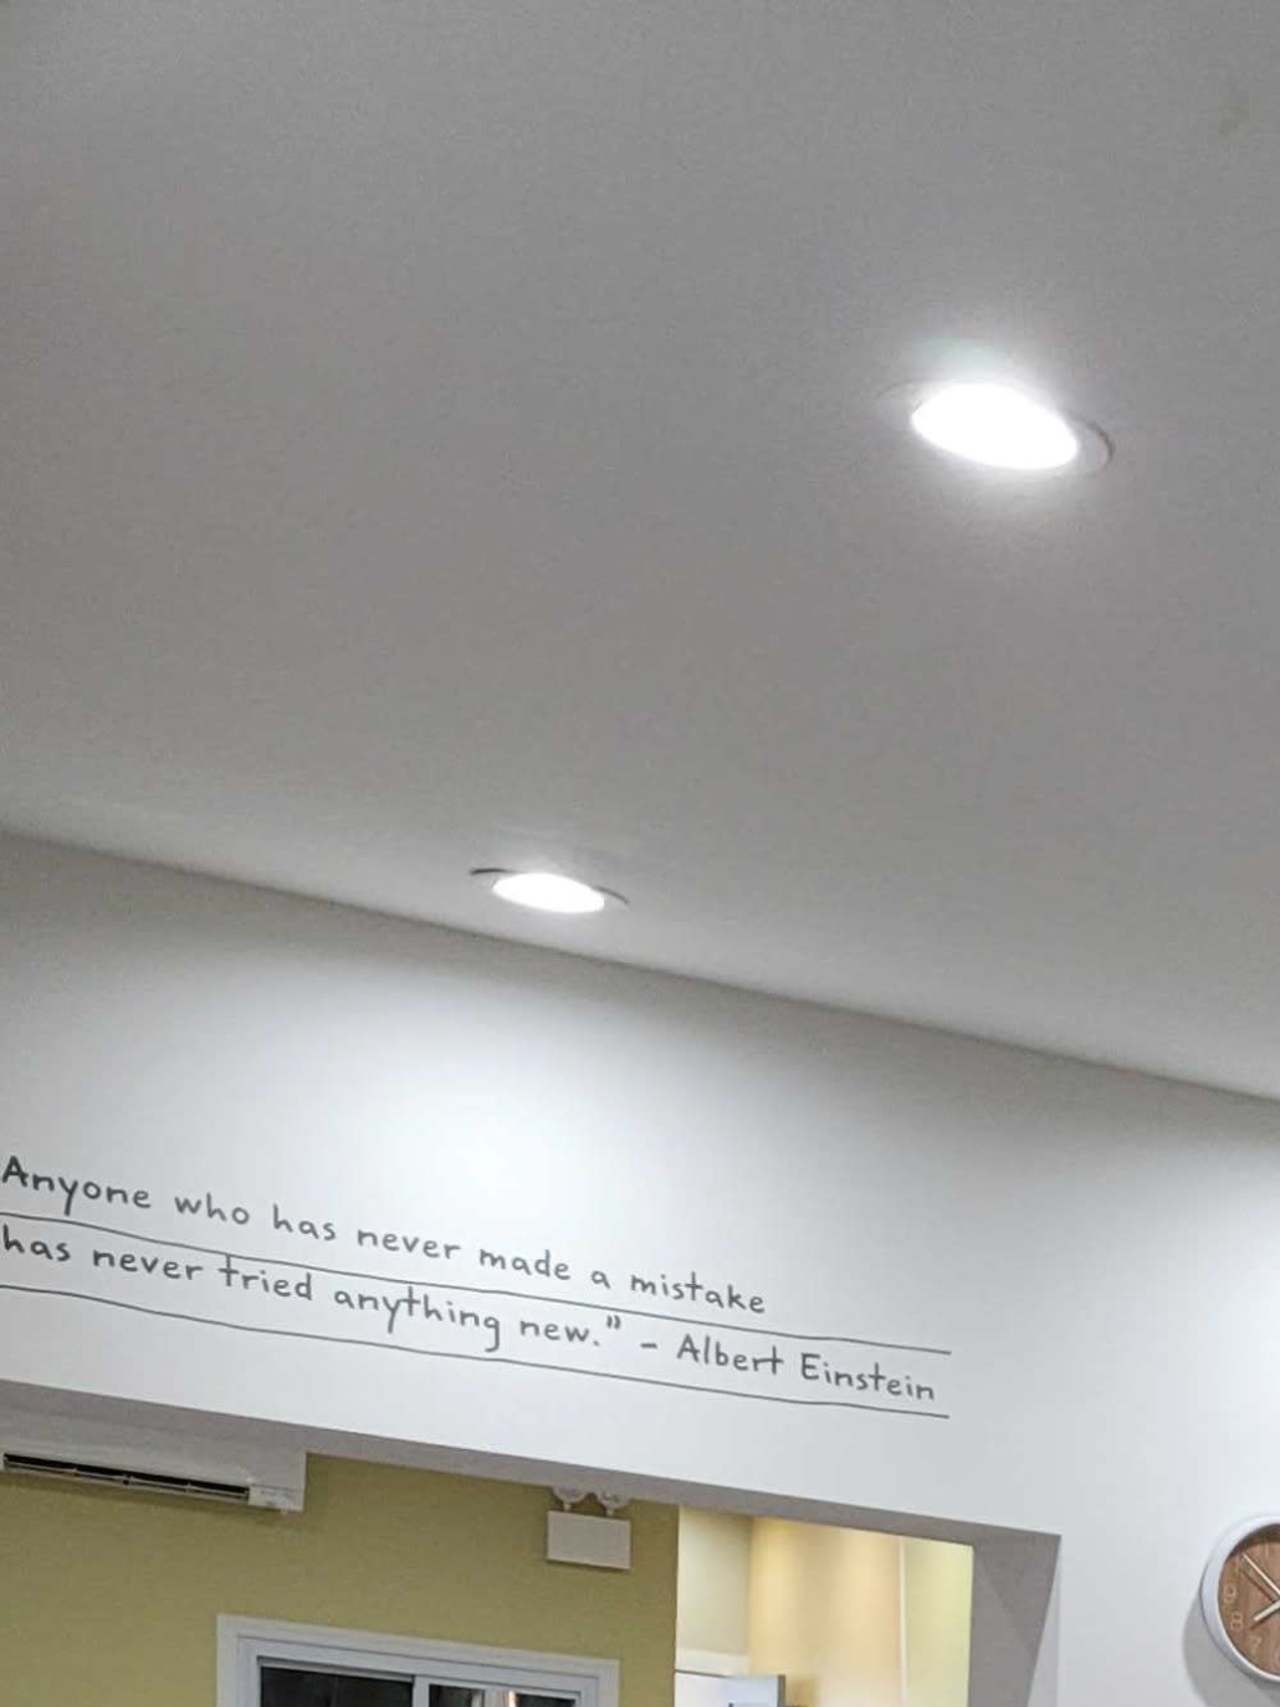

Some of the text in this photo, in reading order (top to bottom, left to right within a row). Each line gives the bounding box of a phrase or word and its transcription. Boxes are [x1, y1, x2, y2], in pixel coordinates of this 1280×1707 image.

[2, 1155, 766, 1314] Anyone who has never made a mistake
[2, 1225, 71, 1262] has
[93, 1249, 204, 1281] never
[218, 1254, 312, 1300] tried
[335, 1286, 501, 1352] anything
[677, 1334, 784, 1375] Albert
[801, 1352, 935, 1401] Einstein
